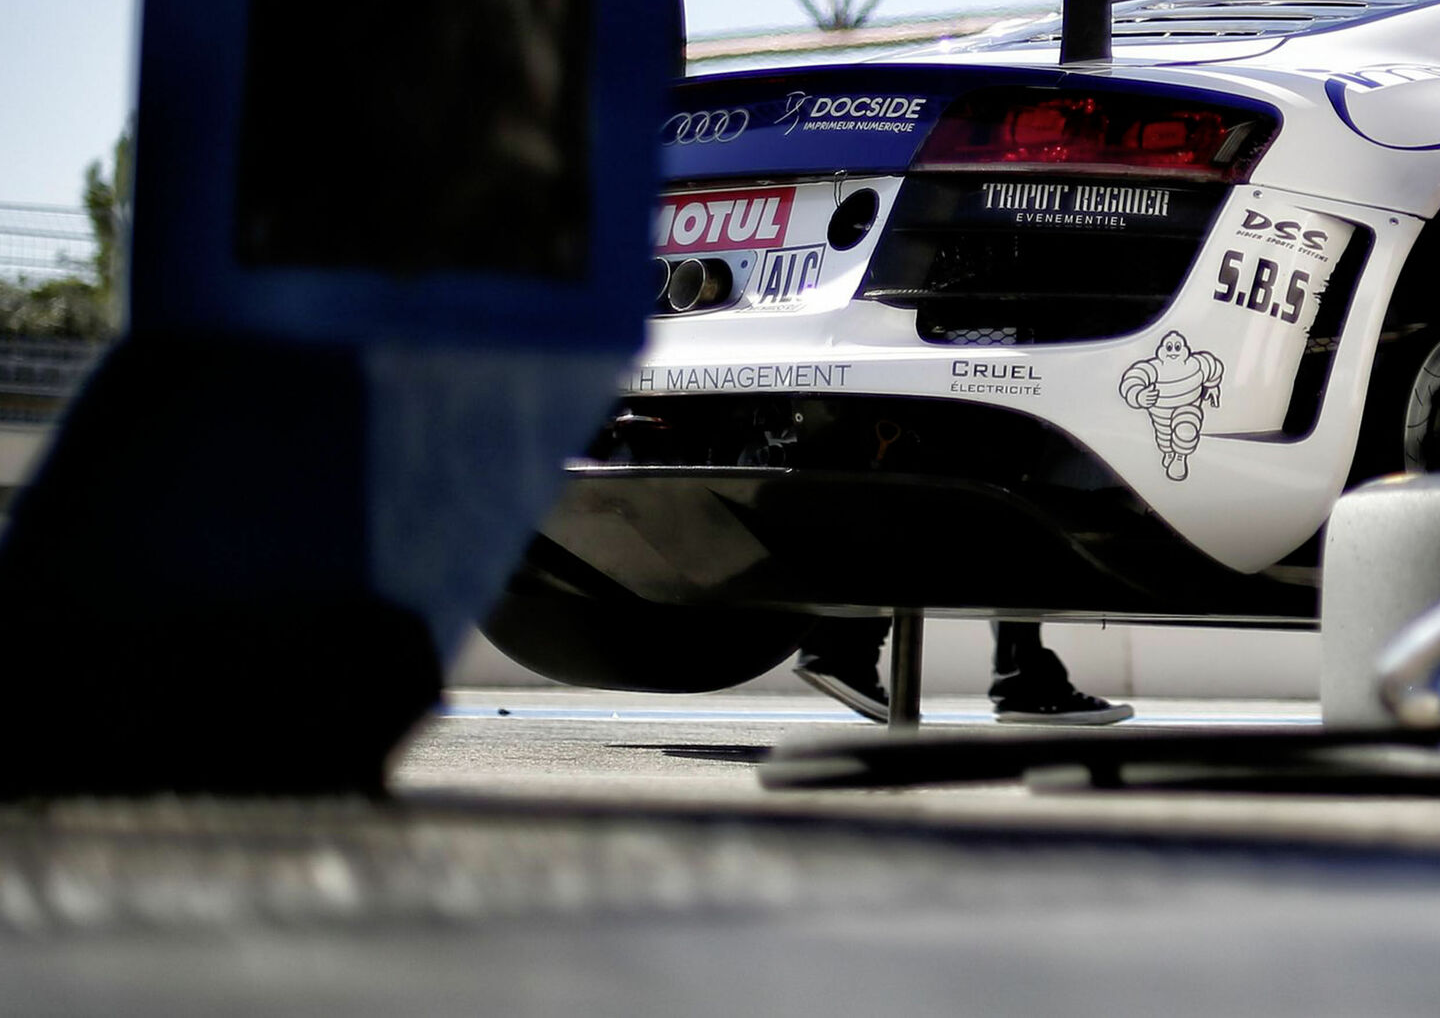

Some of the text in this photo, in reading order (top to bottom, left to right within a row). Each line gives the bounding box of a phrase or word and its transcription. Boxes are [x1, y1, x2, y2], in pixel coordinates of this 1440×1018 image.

[810, 97, 926, 118] DOCSIDE
[803, 121, 915, 133] IMPRIMEUR NUMERIQUE
[982, 183, 1170, 216] TRIPOT REGNIER
[1016, 213, 1127, 226] EVENEMENTIEL
[1241, 208, 1328, 250] DSS
[1213, 249, 1310, 324] S.B.S
[666, 365, 851, 390] MANAGEMENT
[951, 360, 1042, 381] CRUEL
[950, 381, 1042, 396] ÉLECTRICITÉ
